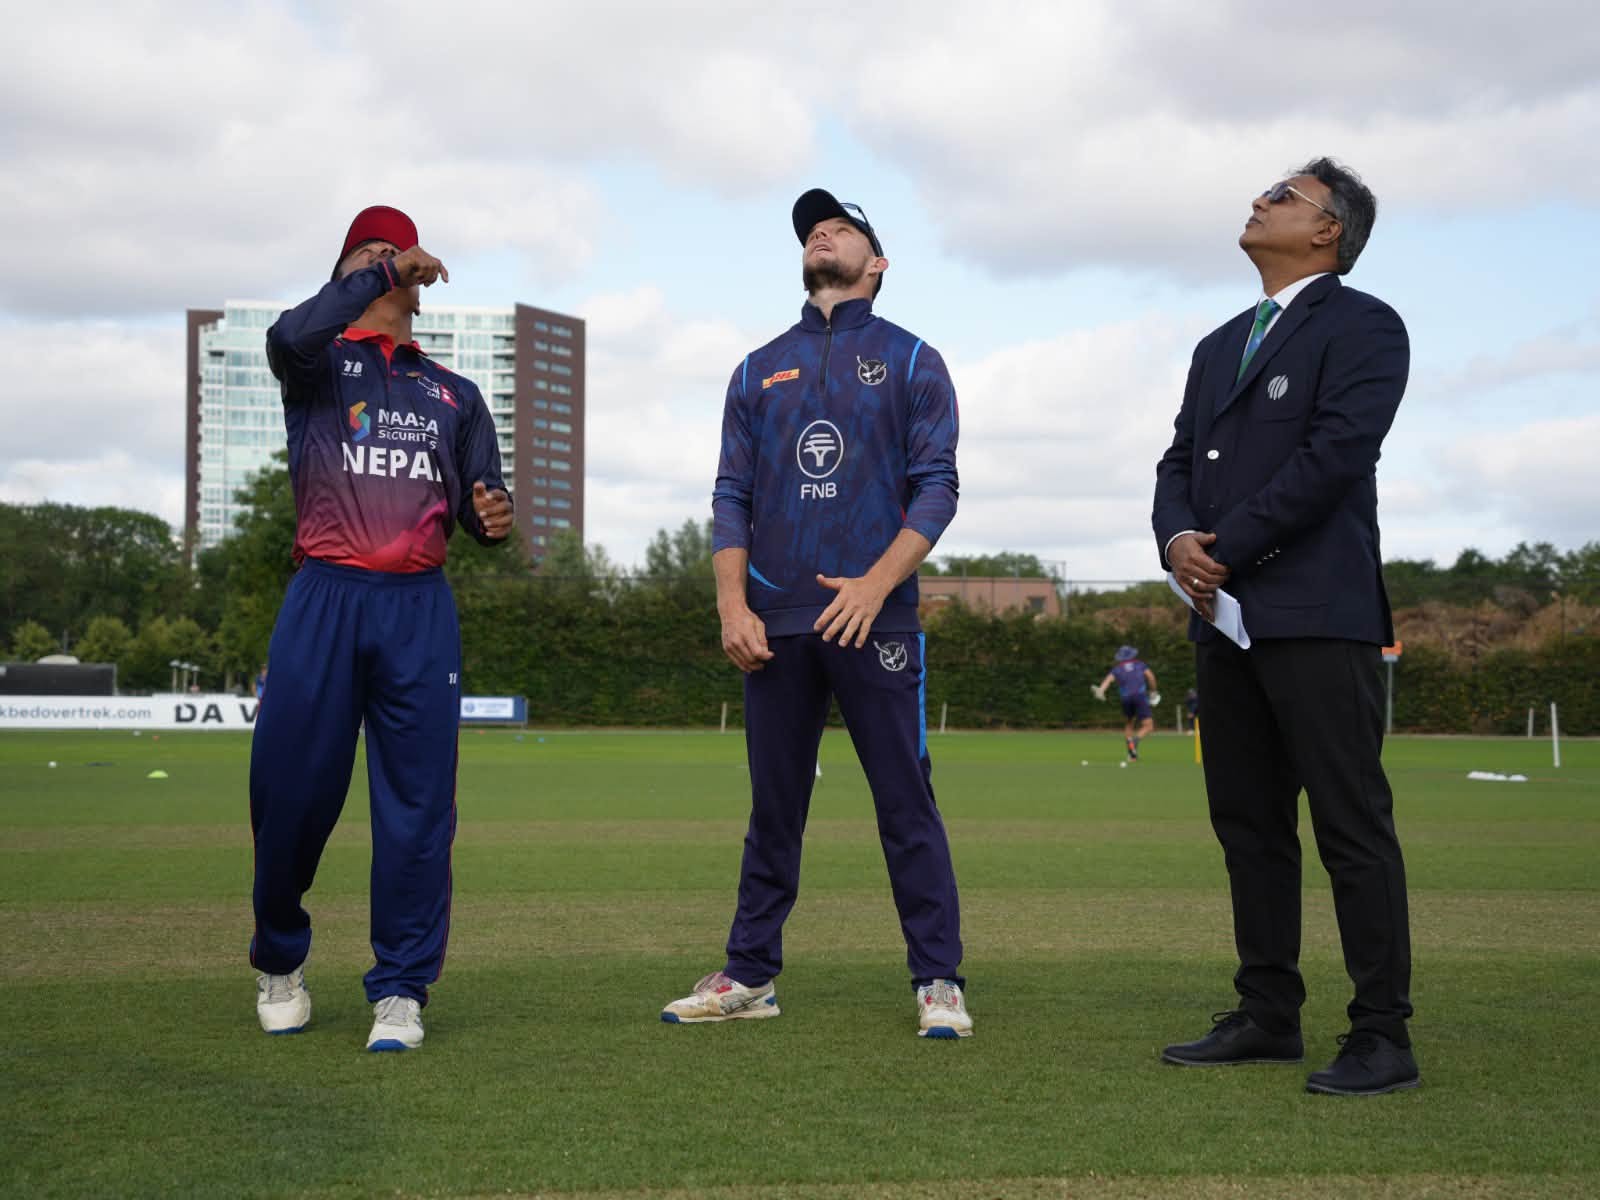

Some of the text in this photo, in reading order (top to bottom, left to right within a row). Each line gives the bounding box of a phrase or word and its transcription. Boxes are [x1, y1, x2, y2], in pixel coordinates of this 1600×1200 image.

[341, 441, 443, 482] NEPA
[800, 482, 838, 500] FNB
[175, 703, 224, 723] DA
